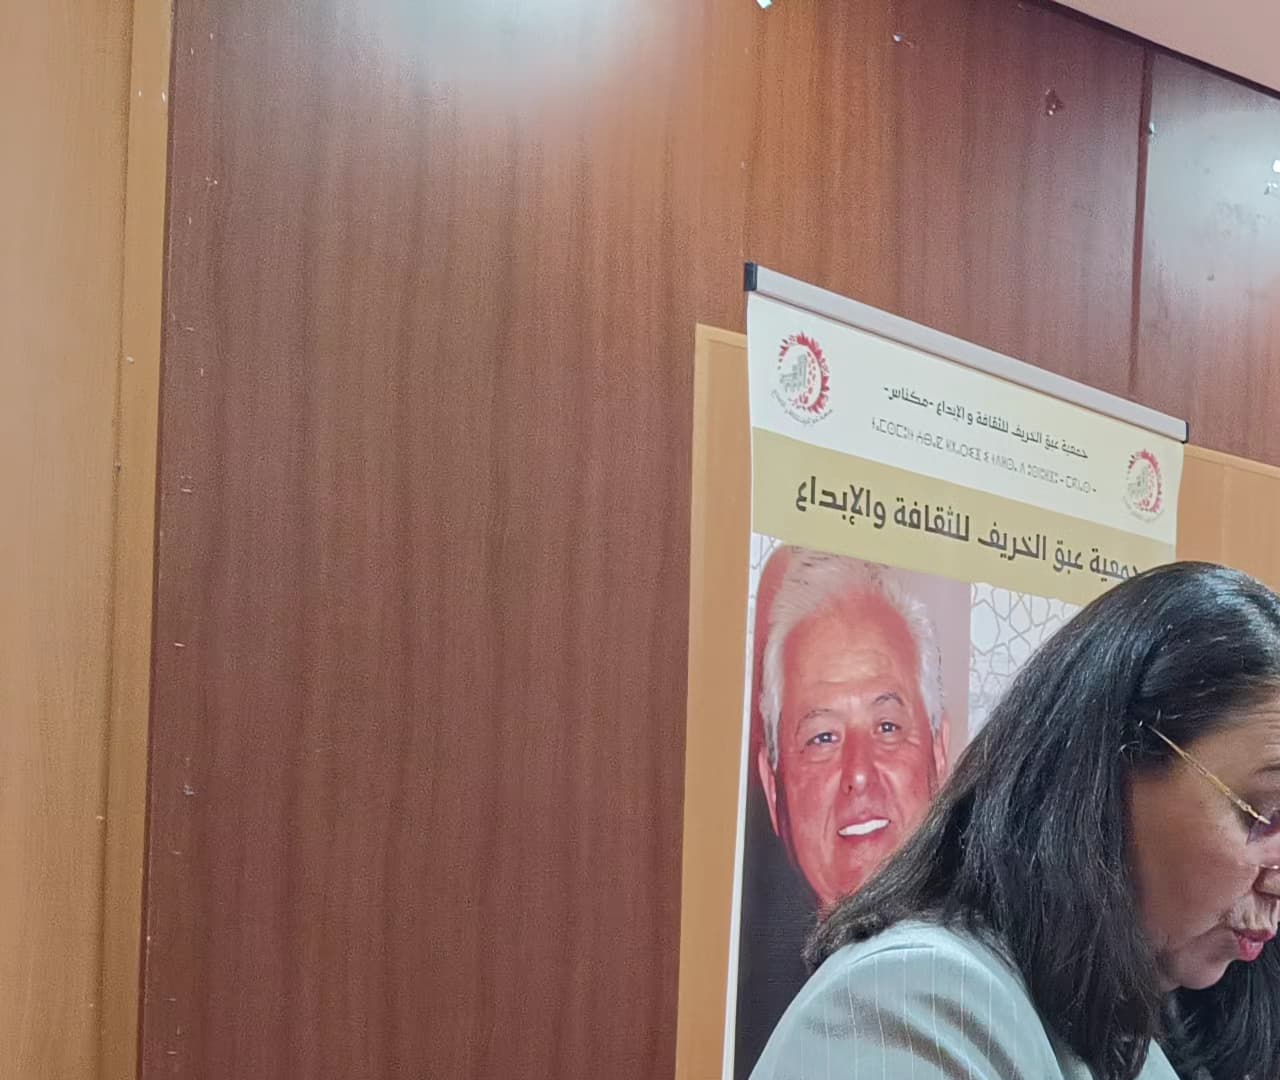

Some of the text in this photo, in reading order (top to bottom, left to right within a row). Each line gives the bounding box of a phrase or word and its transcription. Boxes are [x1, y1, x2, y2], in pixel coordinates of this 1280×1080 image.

[795, 475, 1138, 582] معية عبق الخريف للثقافة والإبداع
